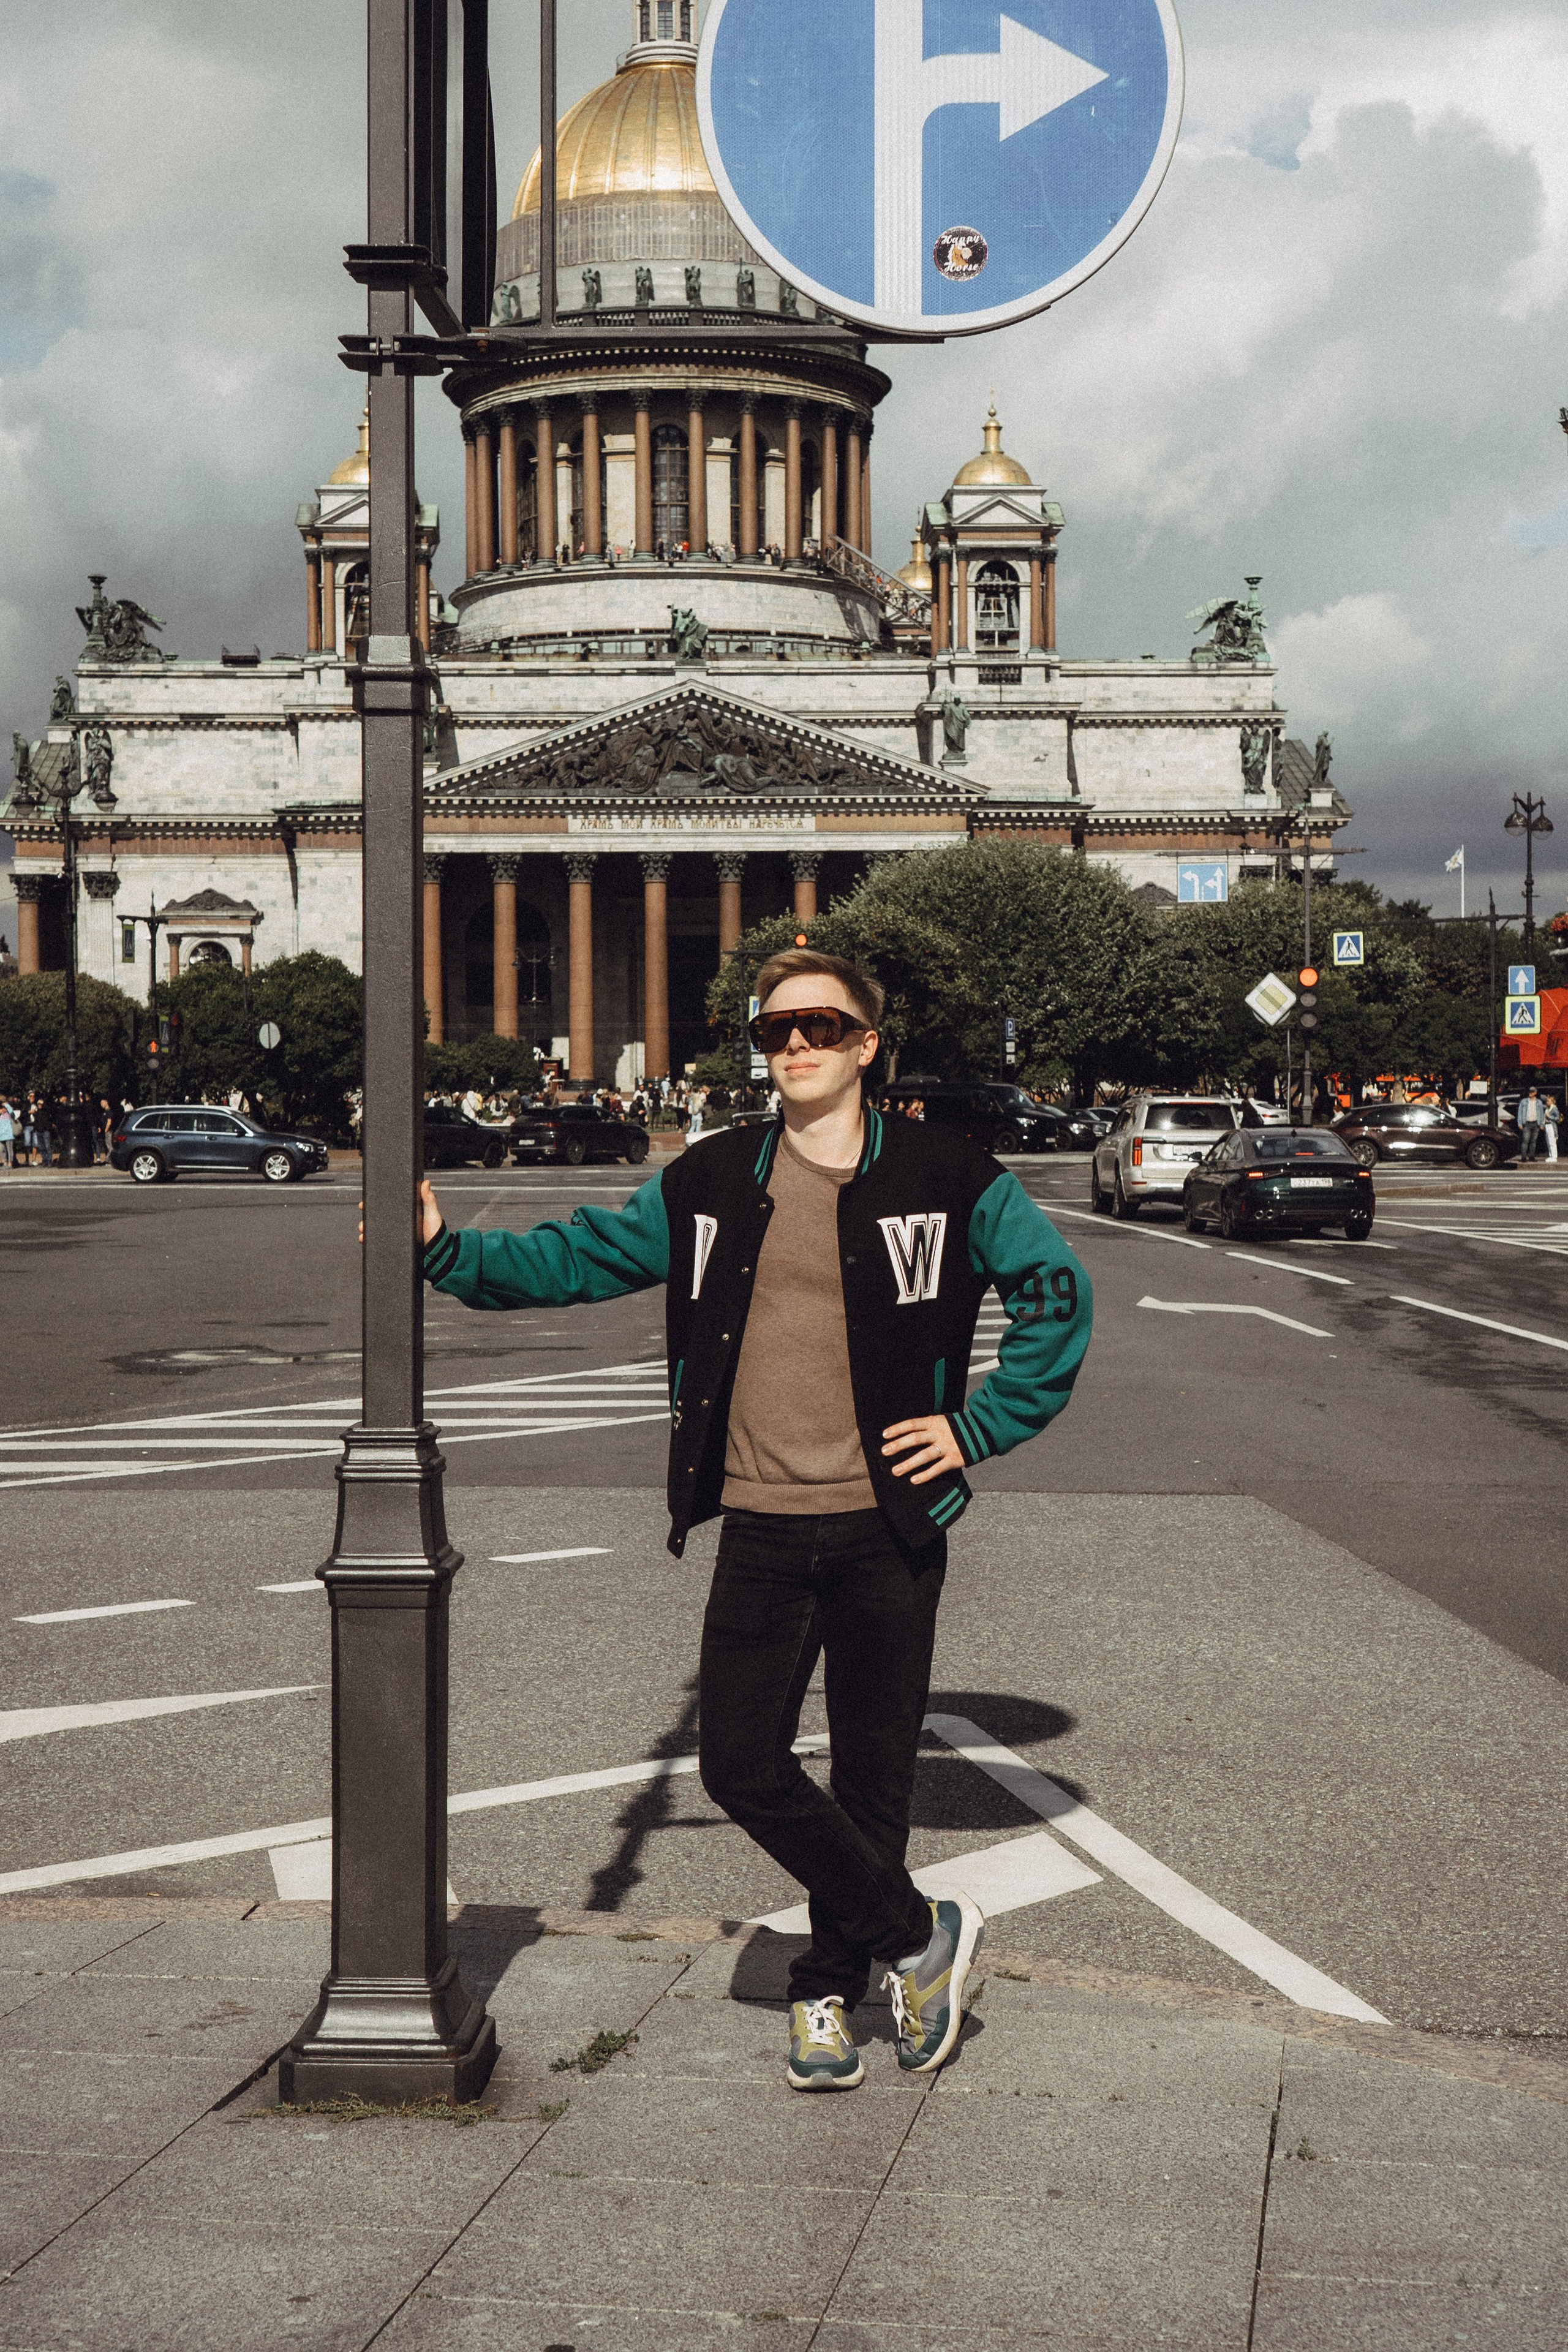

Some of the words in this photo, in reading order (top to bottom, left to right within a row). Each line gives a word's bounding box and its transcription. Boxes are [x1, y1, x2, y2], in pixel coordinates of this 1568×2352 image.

[941, 235, 979, 246] Happy
[944, 262, 978, 272] Horse
[876, 1213, 947, 1305] W
[1016, 1266, 1078, 1323] 99
